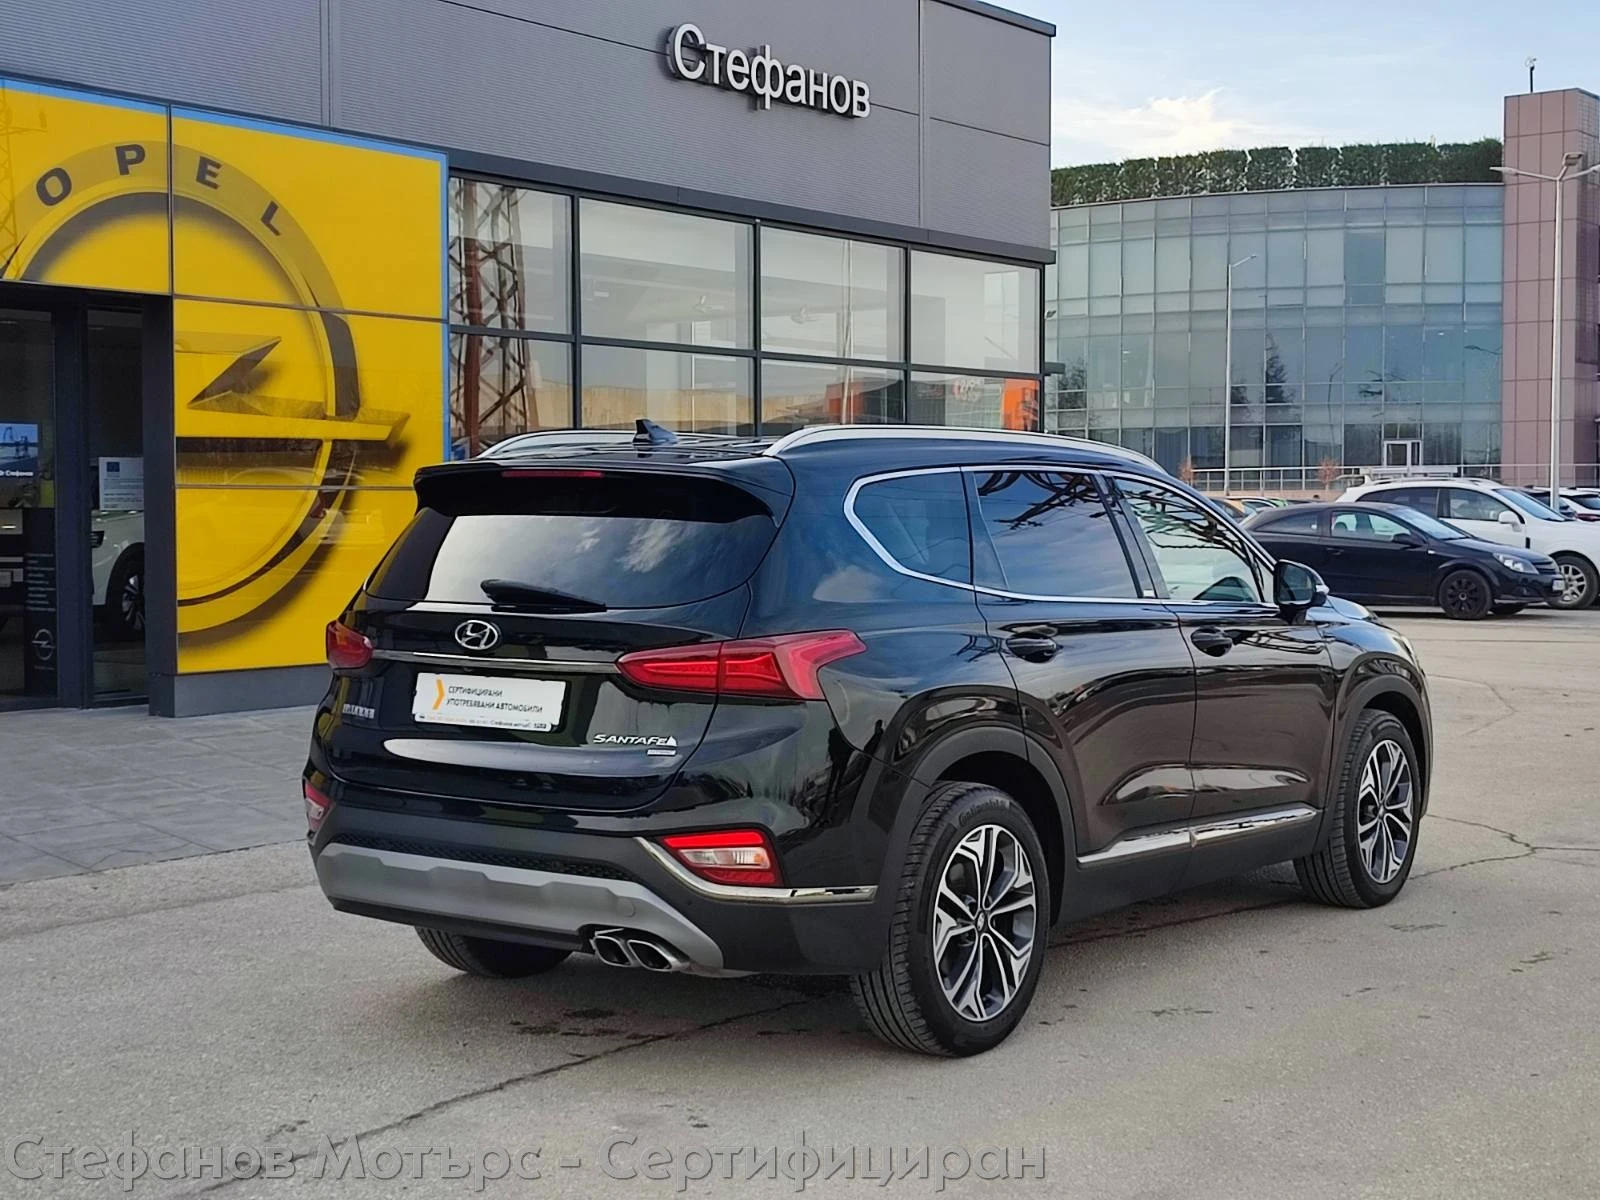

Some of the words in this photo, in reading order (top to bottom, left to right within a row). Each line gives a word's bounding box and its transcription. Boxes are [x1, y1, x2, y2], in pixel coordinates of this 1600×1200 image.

[673, 22, 871, 118] Стефанов
[36, 143, 281, 236] OPEL
[448, 685, 503, 697] СЕРТИФИЦИРАНИ
[496, 702, 543, 713] АВТОМОБИЛИ
